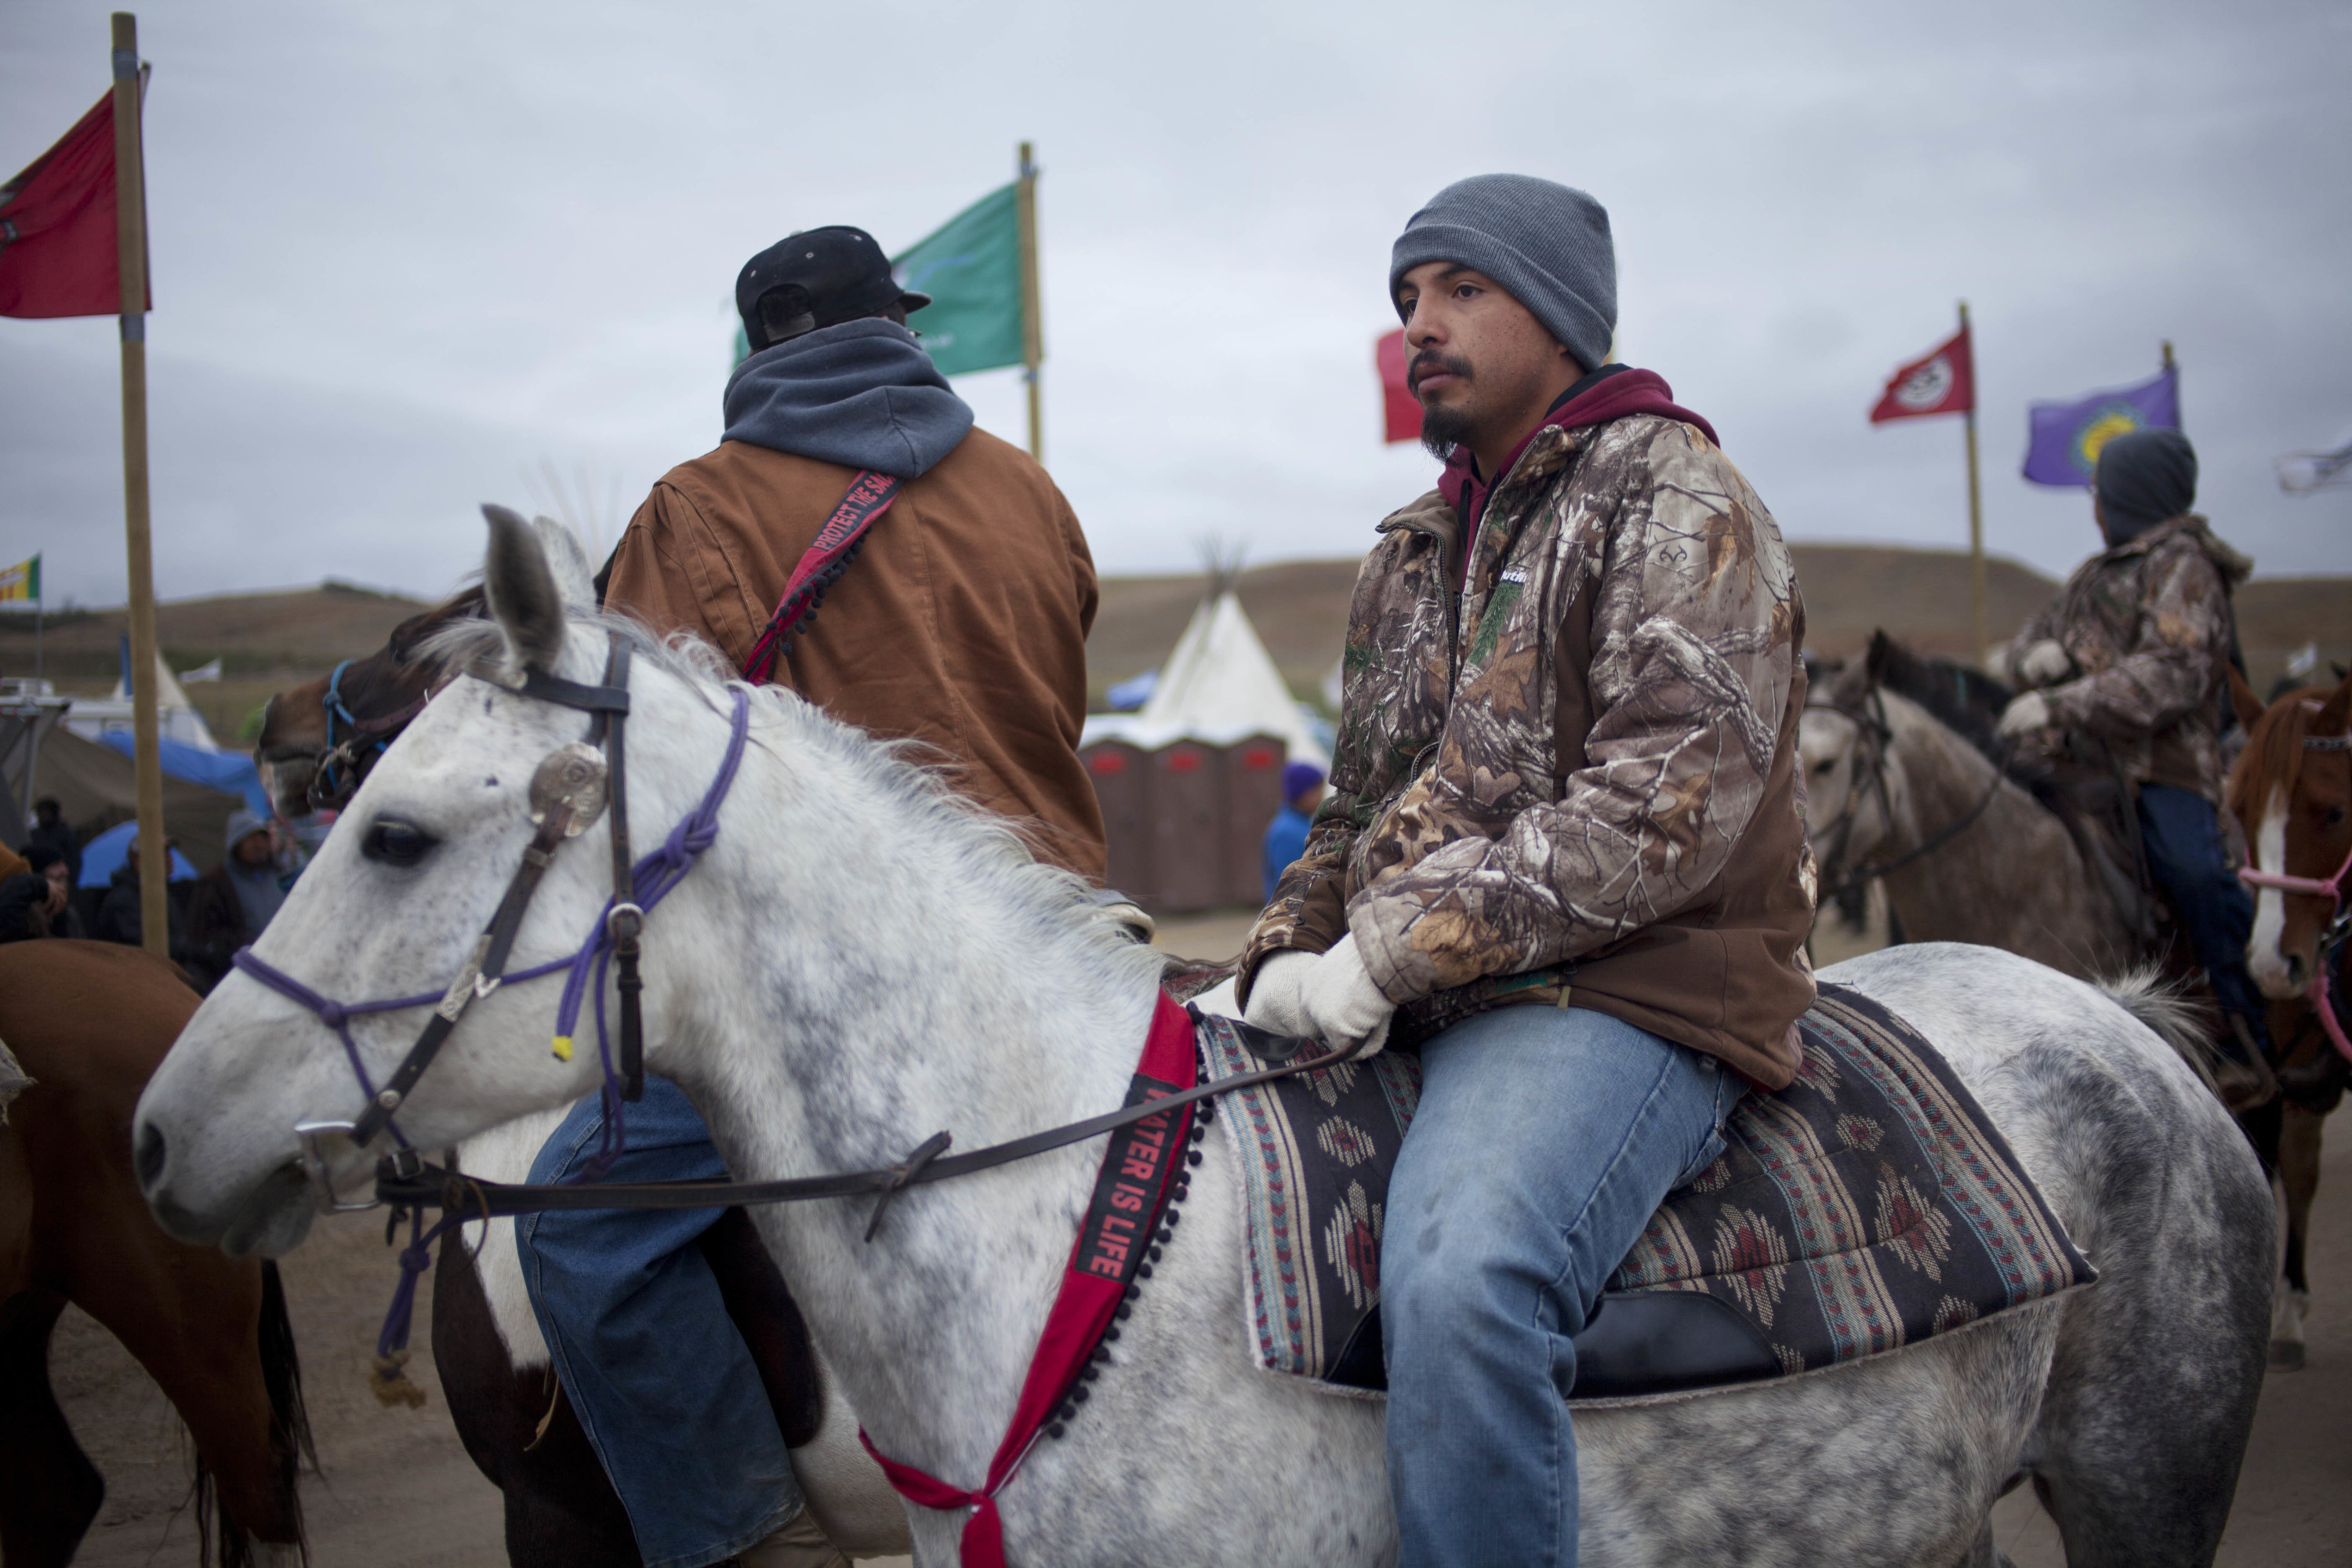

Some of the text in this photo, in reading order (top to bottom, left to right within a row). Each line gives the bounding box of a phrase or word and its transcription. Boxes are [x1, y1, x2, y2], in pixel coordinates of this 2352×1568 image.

[813, 472, 896, 552] PROTECT THE SAC
[1110, 1181, 1146, 1213] IS
[1089, 1214, 1136, 1279] LIFE
